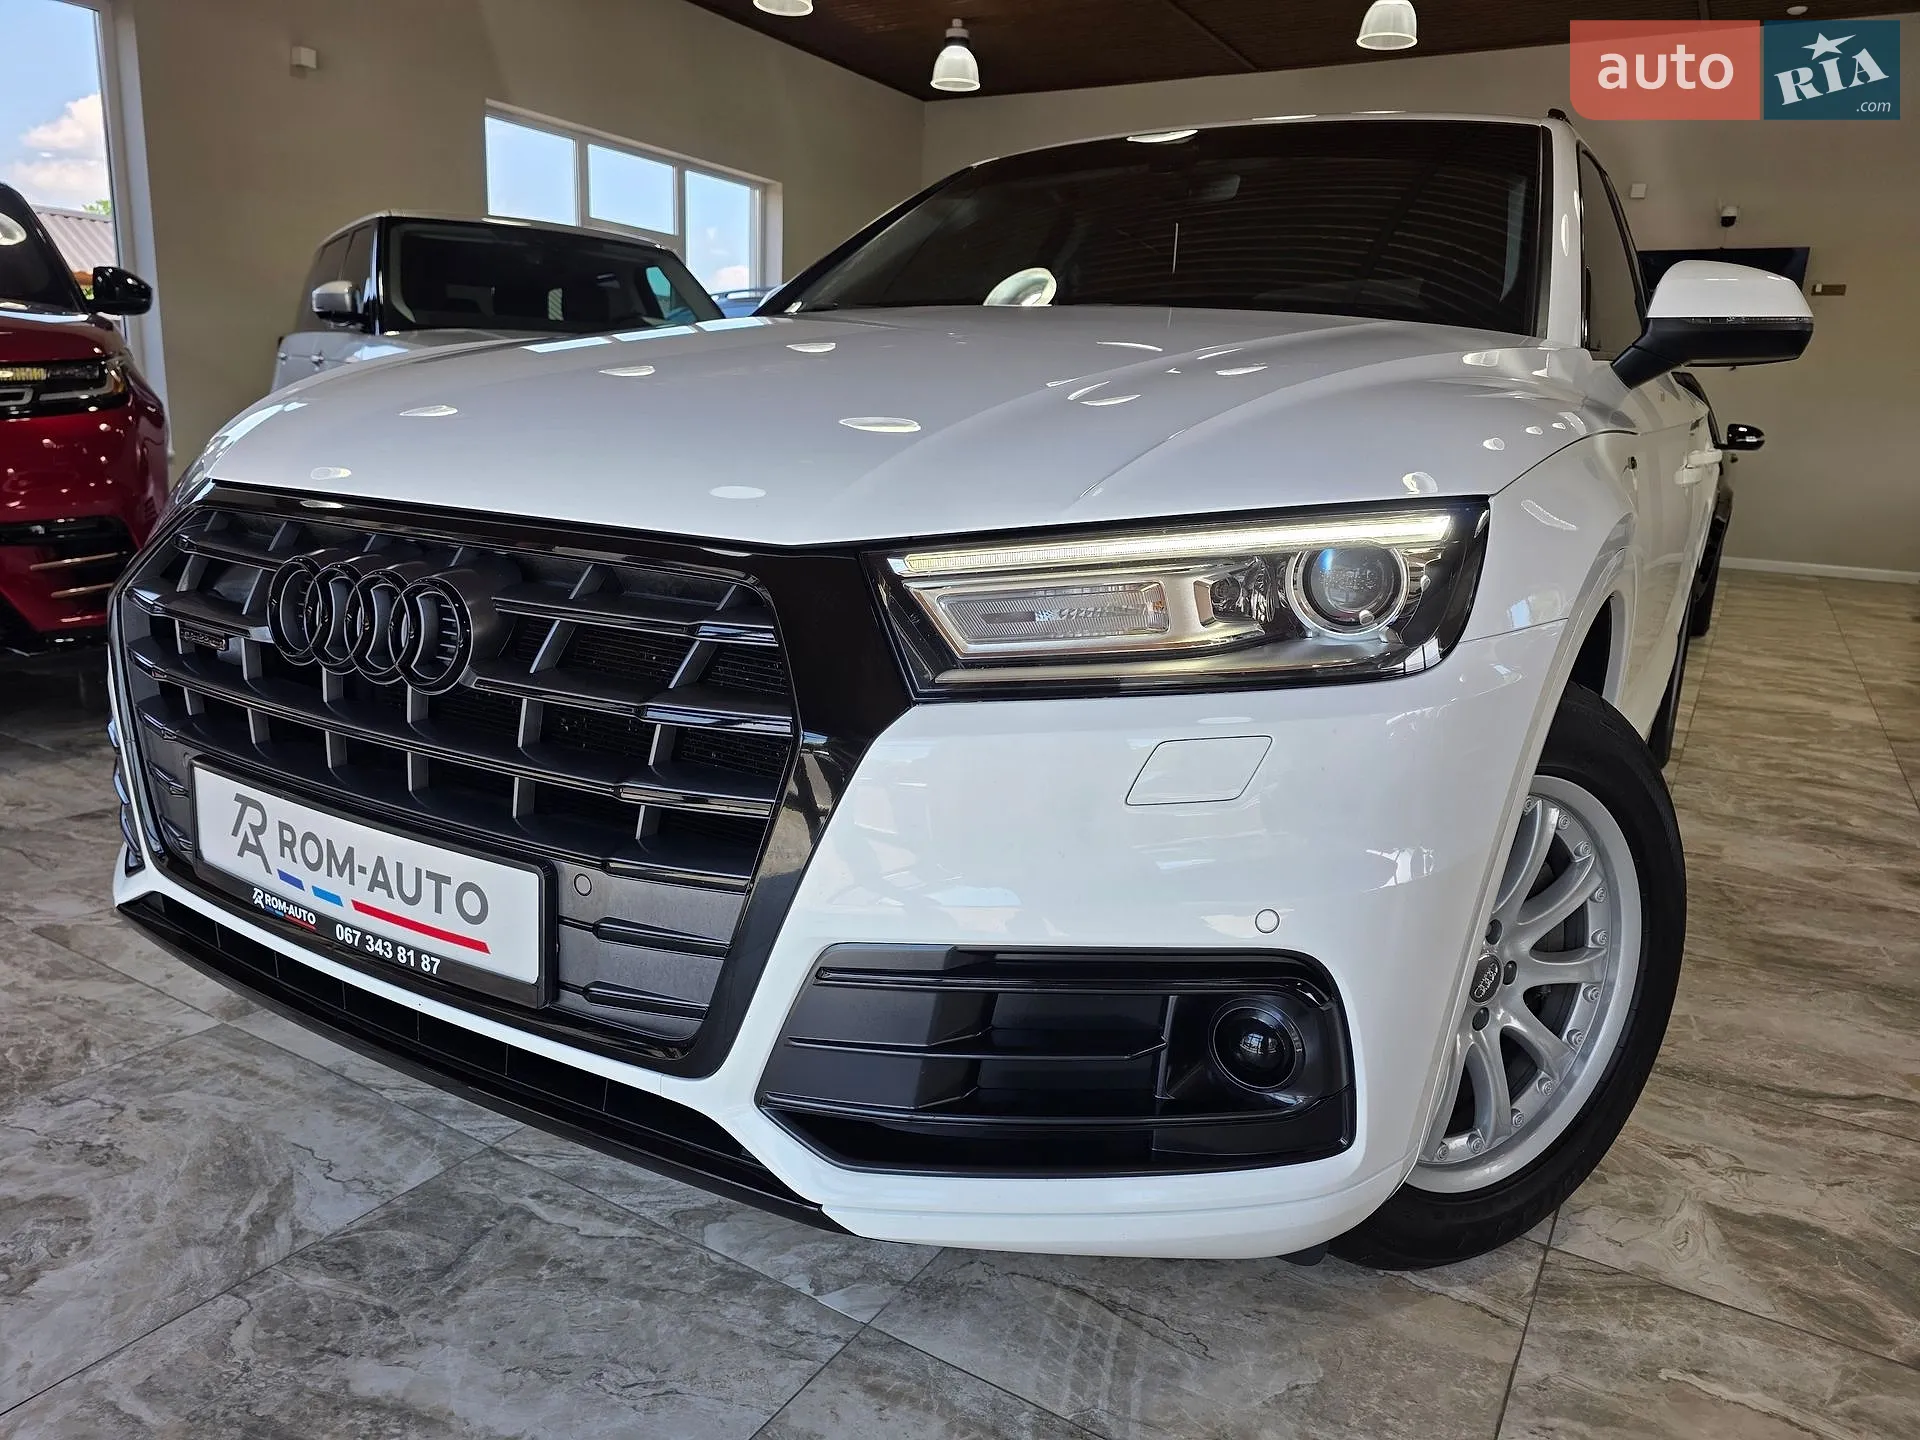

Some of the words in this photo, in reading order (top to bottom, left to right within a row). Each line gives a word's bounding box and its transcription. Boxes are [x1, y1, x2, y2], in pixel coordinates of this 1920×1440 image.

[278, 820, 489, 926] ROM-AUTO
[265, 893, 317, 925] ROM-AUTO
[335, 923, 362, 948] 067
[365, 934, 393, 959] 343
[397, 946, 415, 967] 81
[420, 955, 441, 975] 87
